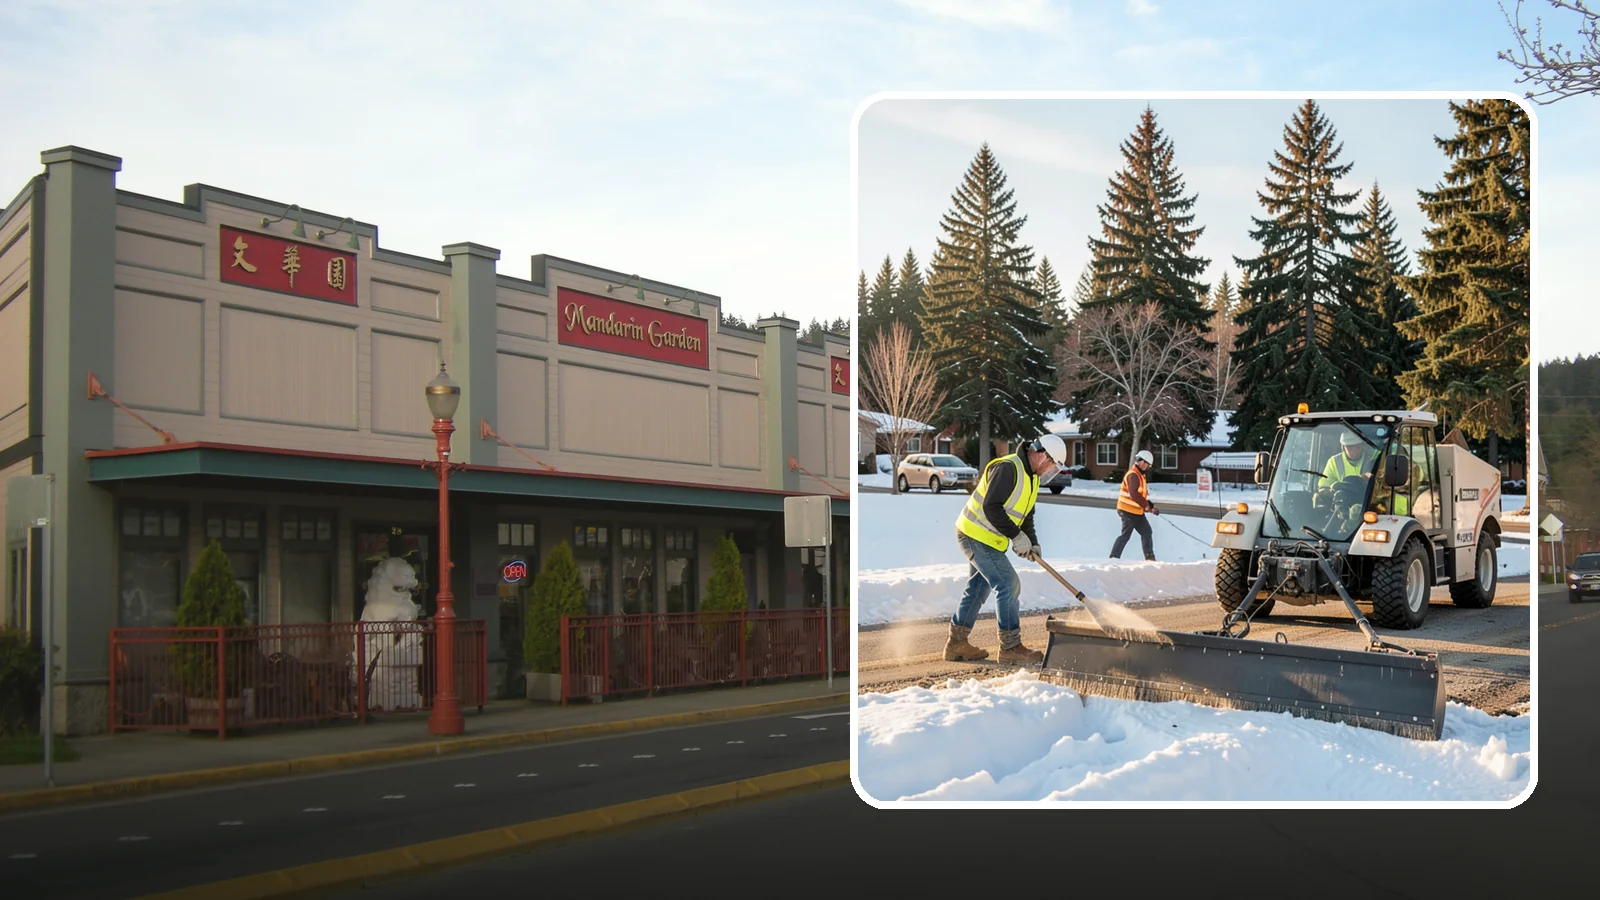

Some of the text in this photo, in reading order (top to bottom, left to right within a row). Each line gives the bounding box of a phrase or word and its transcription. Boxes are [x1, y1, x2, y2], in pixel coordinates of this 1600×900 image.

[231, 235, 346, 291] 文華園
[564, 302, 701, 352] Mandarin Garden
[503, 565, 527, 578] OPEN
